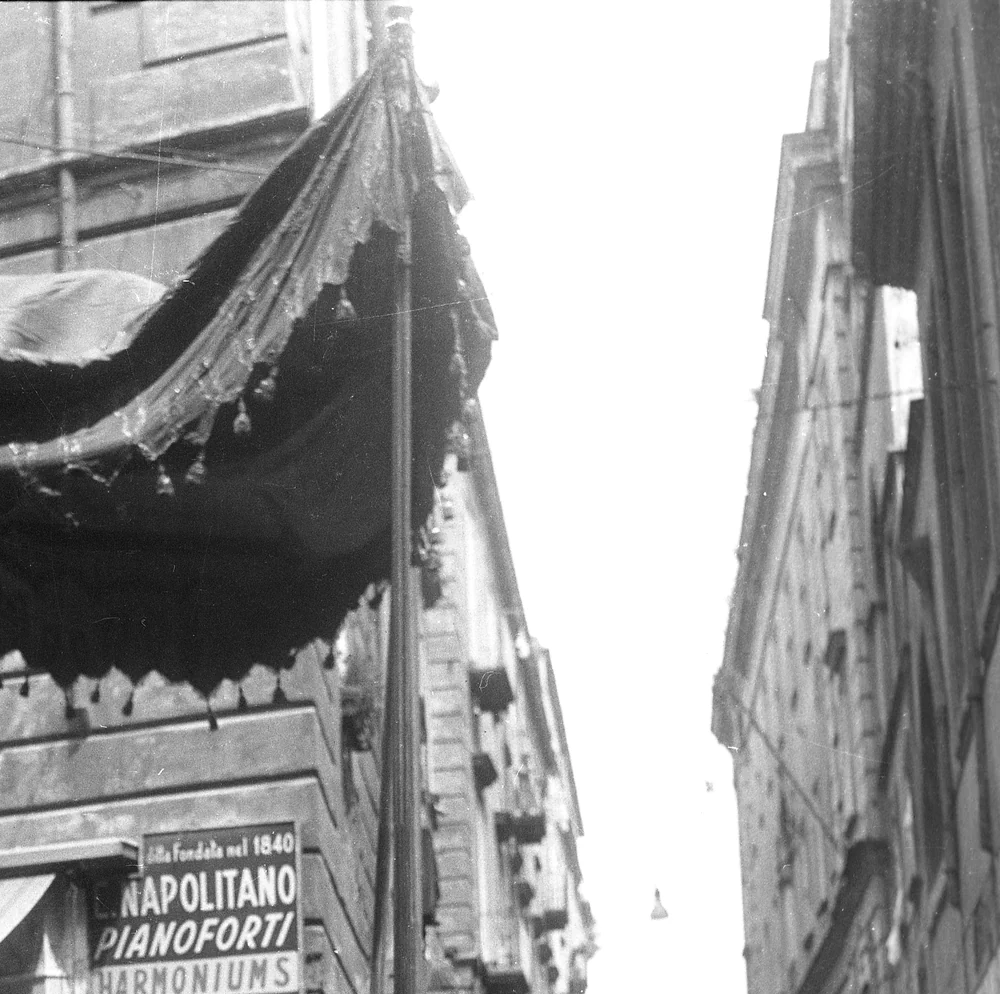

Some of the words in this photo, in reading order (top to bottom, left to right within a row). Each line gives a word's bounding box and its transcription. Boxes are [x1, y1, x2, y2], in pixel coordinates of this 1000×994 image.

[226, 836, 249, 858] nel
[253, 832, 295, 857] 1840
[121, 864, 297, 918] NAPOLITANO
[94, 911, 295, 960] PIANOFORTI
